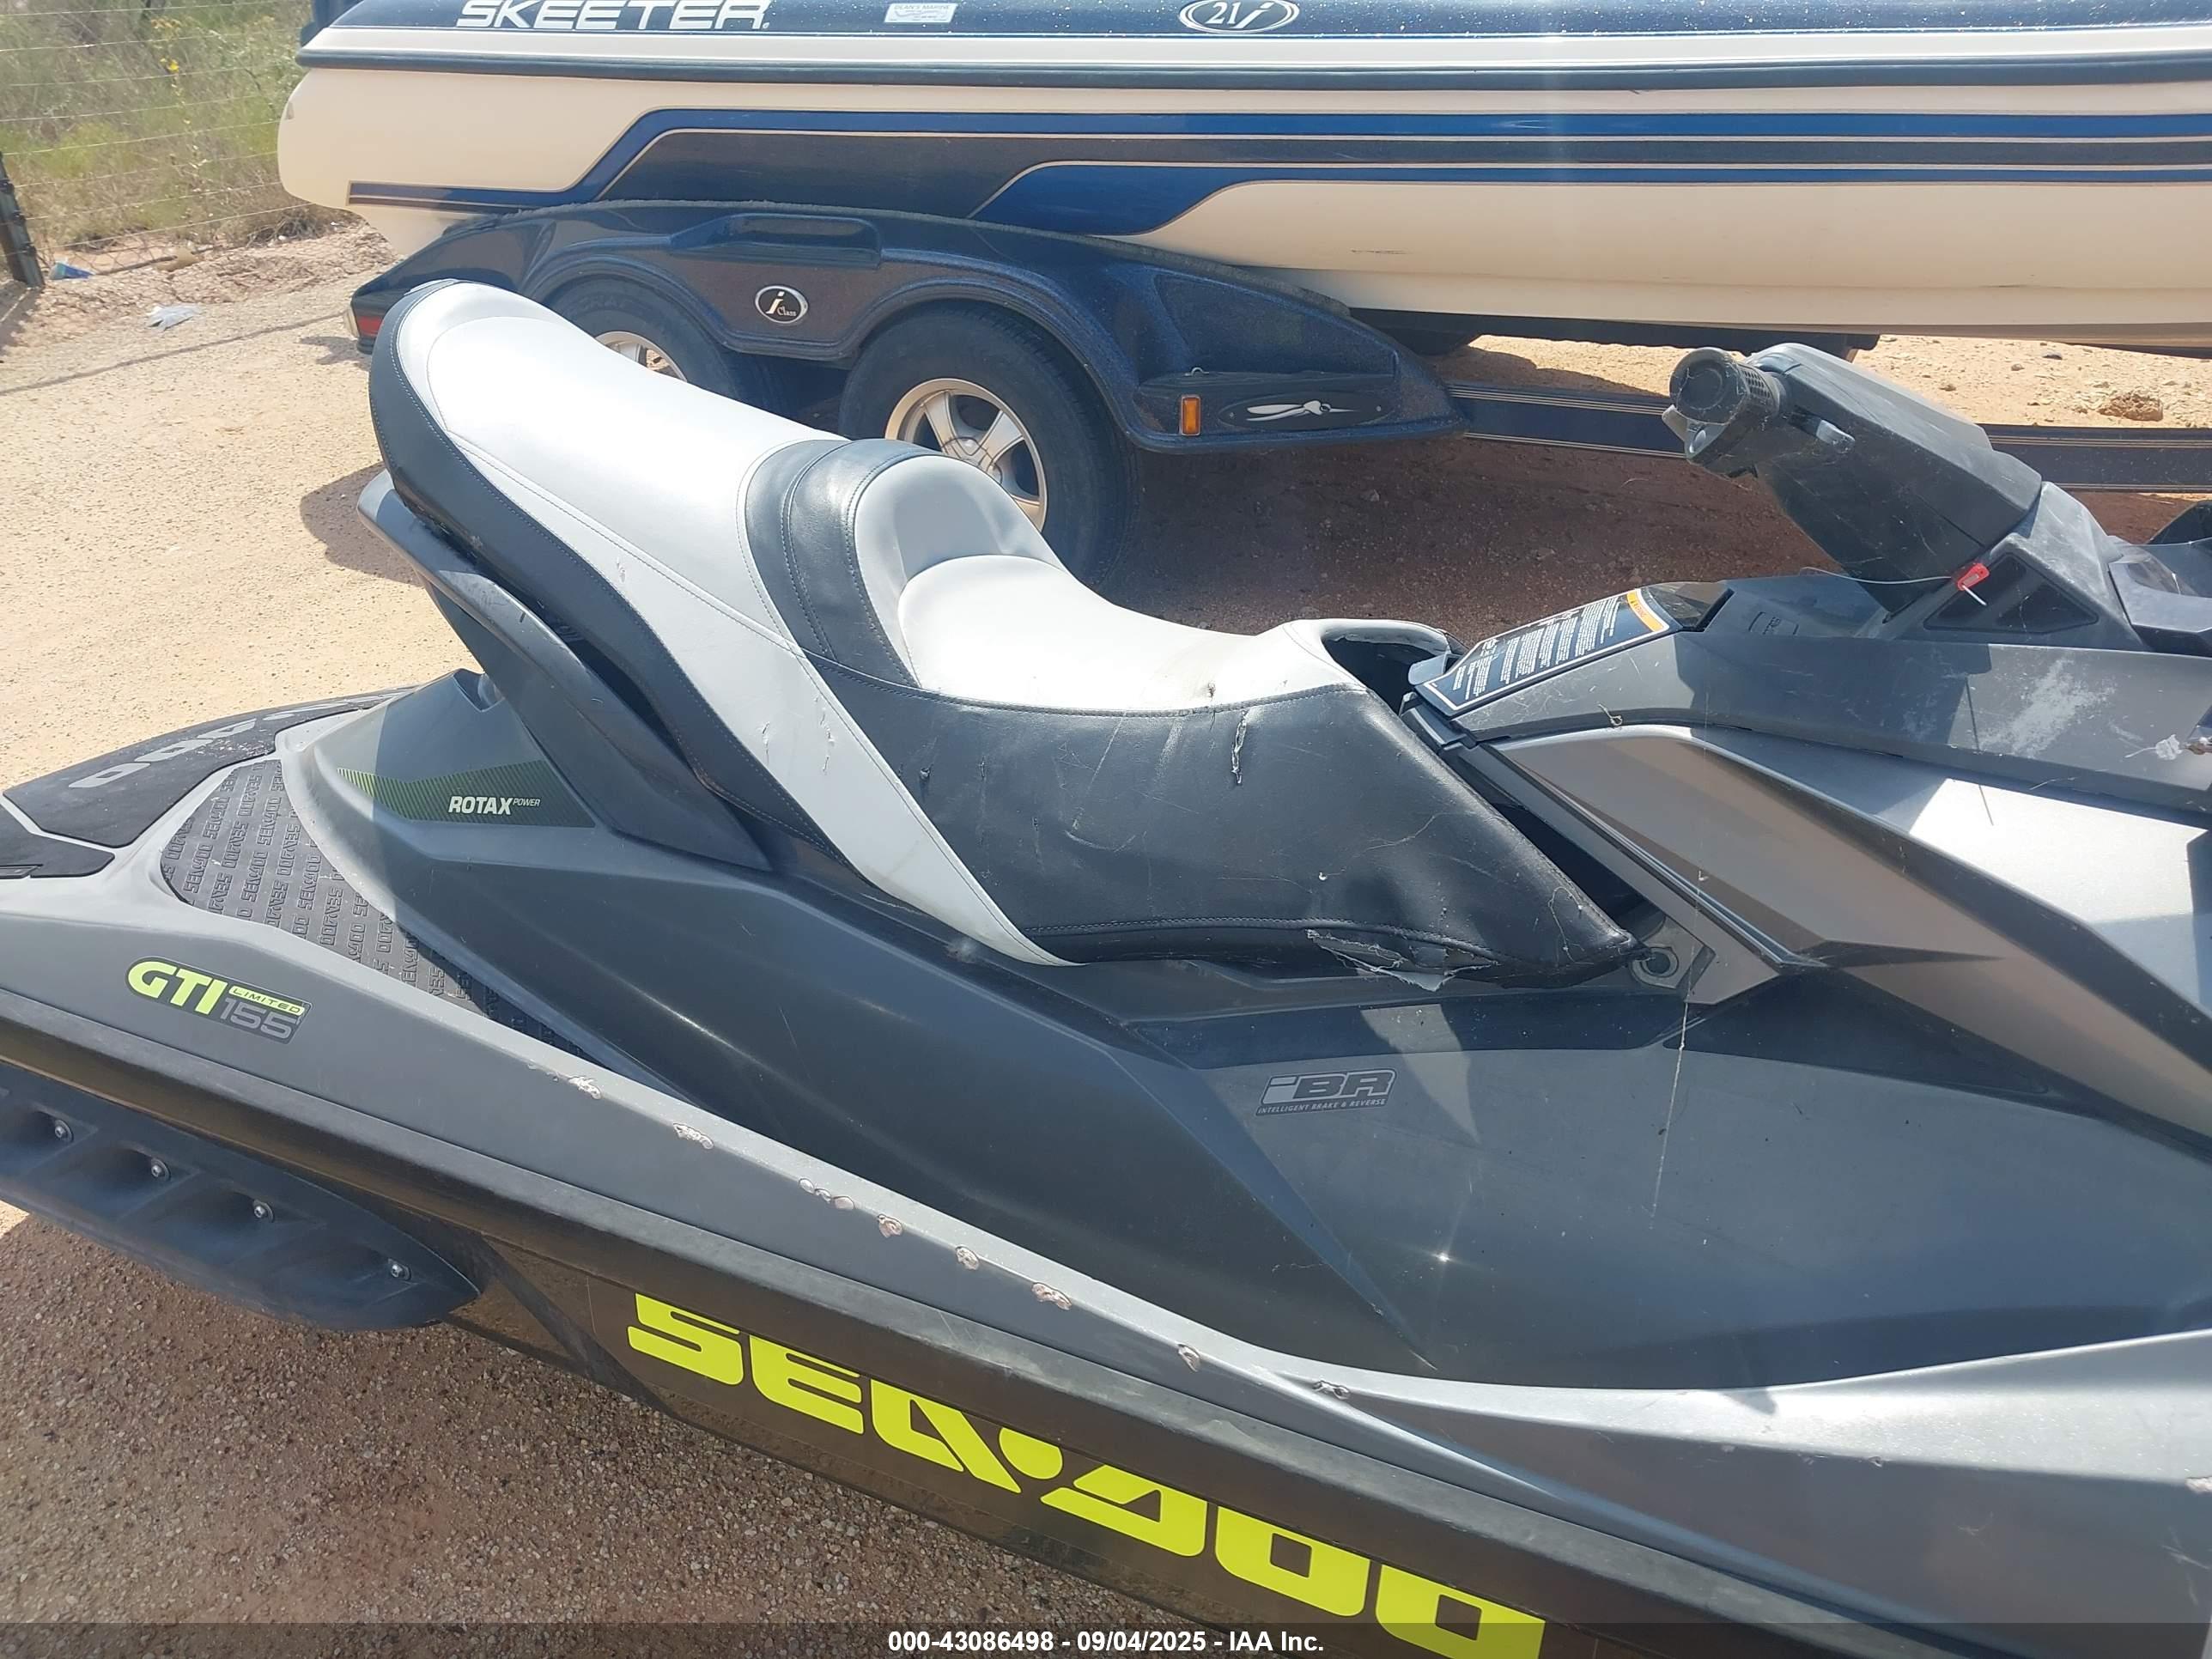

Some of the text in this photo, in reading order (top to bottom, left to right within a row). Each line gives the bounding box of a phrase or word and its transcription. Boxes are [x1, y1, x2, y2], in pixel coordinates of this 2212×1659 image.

[455, 0, 768, 29] SKEETER
[447, 794, 541, 816] ROTAX POWER
[127, 960, 228, 1015] GTI
[233, 988, 302, 1014] LIMITED
[220, 998, 303, 1039] 155
[1257, 1104, 1310, 1115] INTELLIGENT
[1311, 1101, 1340, 1110] BRAKE
[1349, 1098, 1386, 1107] REVERSE
